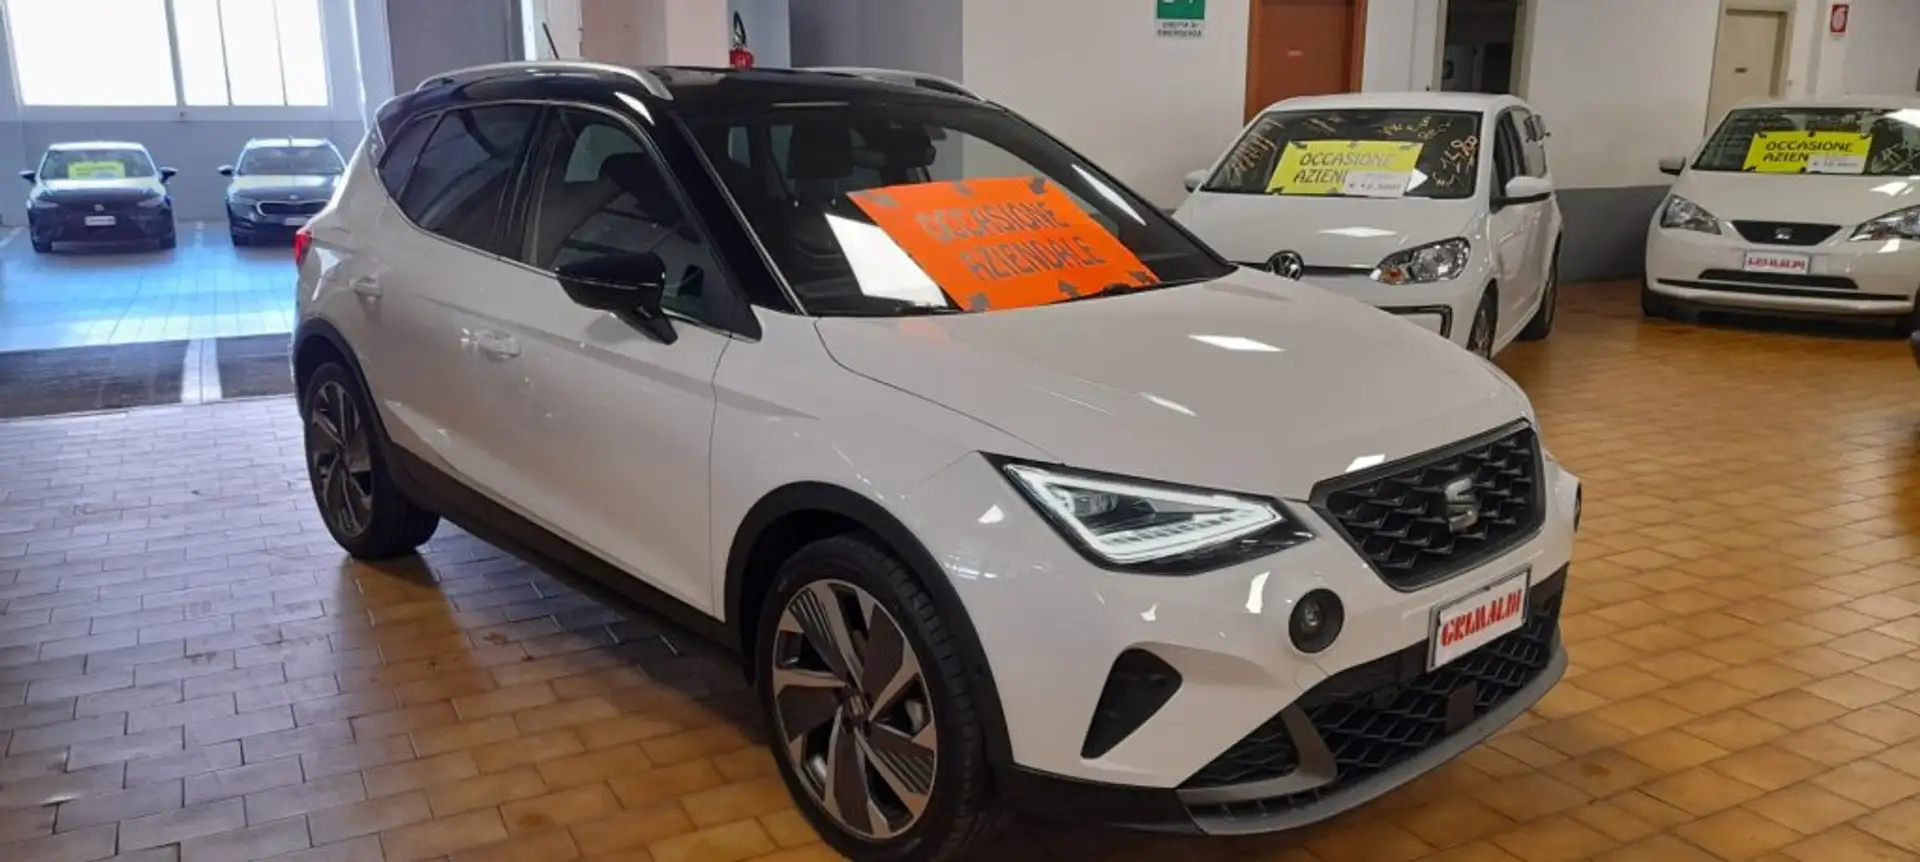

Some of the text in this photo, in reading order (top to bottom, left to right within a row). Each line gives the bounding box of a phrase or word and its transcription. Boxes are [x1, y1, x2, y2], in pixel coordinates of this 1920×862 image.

[1299, 152, 1396, 167] OCCASIONE
[1765, 140, 1853, 153] OCCASIONE
[916, 201, 1070, 243] OCCASIONE
[960, 236, 1105, 281] AZIENDALE
[1441, 588, 1522, 648] GRIMALDI
